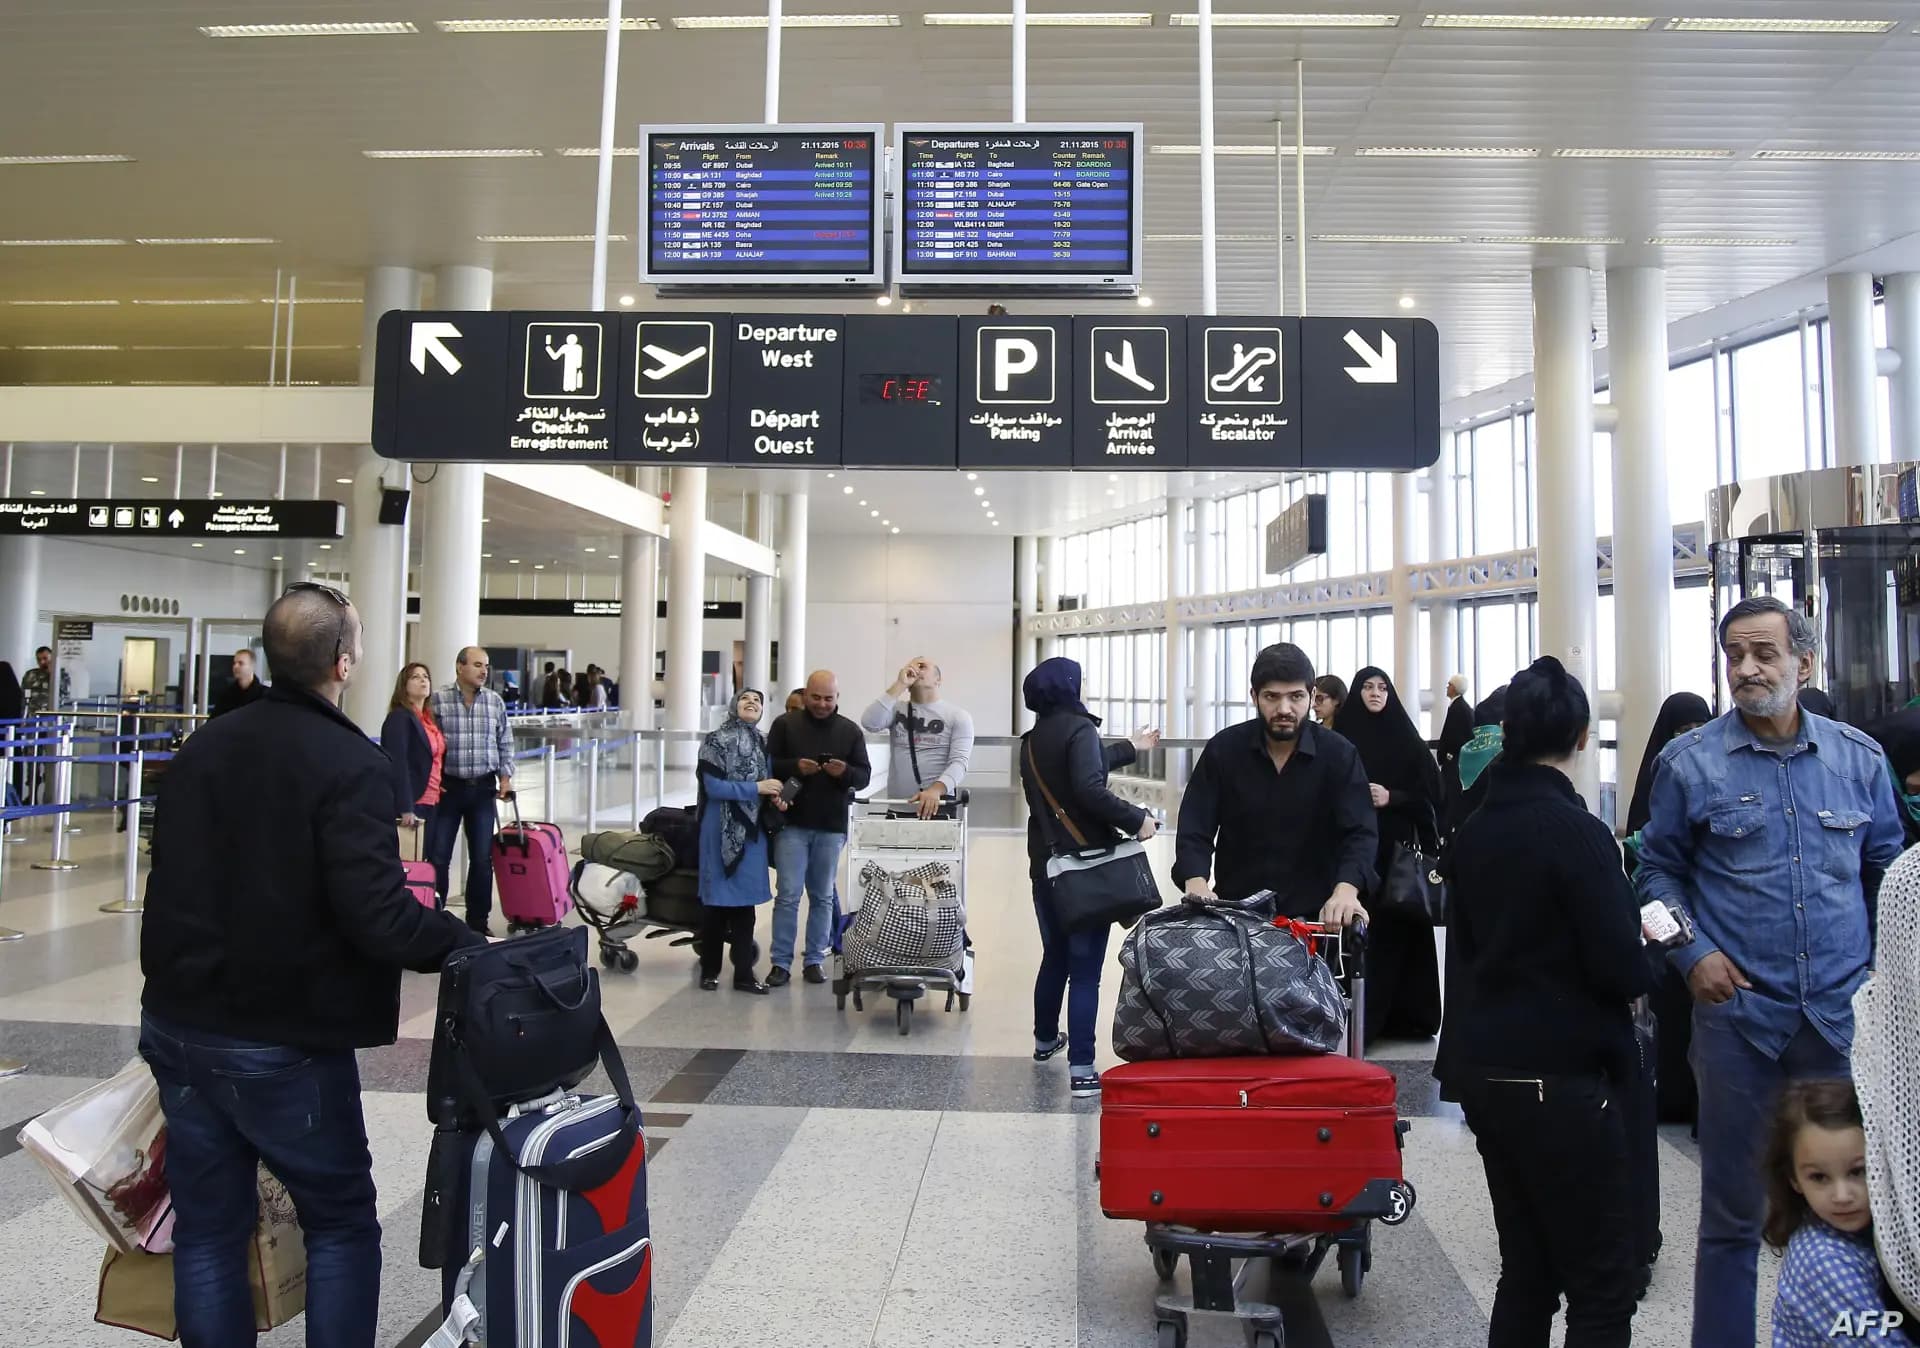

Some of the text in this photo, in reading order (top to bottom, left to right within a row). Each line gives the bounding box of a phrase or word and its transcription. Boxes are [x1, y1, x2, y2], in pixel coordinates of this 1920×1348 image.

[680, 142, 715, 150] Arrivals
[725, 140, 778, 152] الرحلات القادمة
[931, 140, 980, 150] Departures
[1012, 140, 1040, 150] الرحلات
[702, 153, 719, 161] Flight
[738, 323, 838, 345] Departure
[762, 350, 814, 368] West
[994, 338, 1038, 392] P
[516, 406, 606, 422] تسجيل التذاكر
[644, 406, 700, 427] ذهاب
[750, 409, 820, 432] Départ
[969, 412, 1063, 428] مواقف سيارات
[1106, 412, 1156, 428] الوصول
[1199, 413, 1288, 430] سلالم متحركة
[531, 420, 589, 435] Check-In
[990, 427, 1041, 442] Parking
[1108, 427, 1154, 440] Arrival
[1212, 427, 1276, 441] Escalator
[510, 436, 608, 452] Enregistrement
[642, 427, 700, 454] (غرب)
[754, 436, 814, 454] Ouest
[1106, 442, 1156, 455] Arrivée
